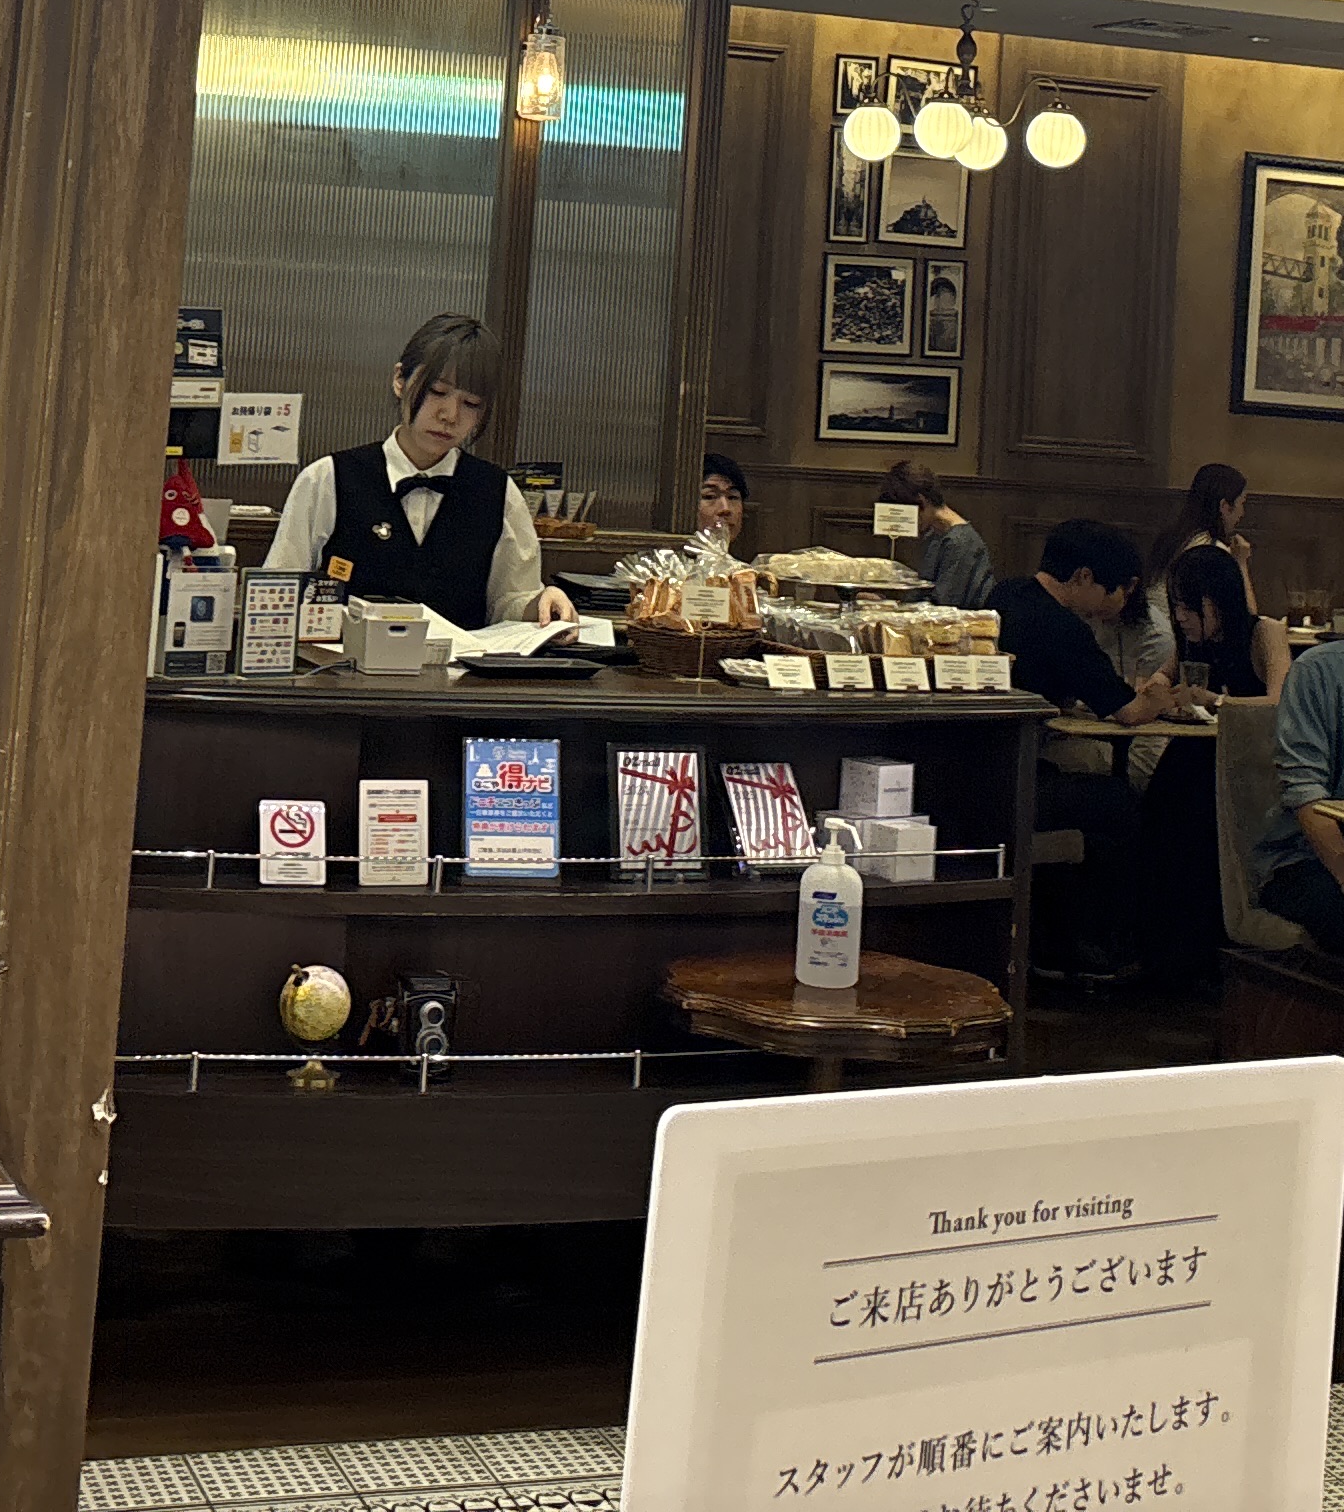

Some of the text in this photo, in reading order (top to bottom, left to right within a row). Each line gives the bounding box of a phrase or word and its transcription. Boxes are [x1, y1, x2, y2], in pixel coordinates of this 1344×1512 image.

[929, 1194, 1134, 1236] Thank you for visiting
[829, 1245, 1208, 1329] ご来店ありがとうございます
[772, 1391, 1233, 1499] スタッフが順番にご案内いたします。
